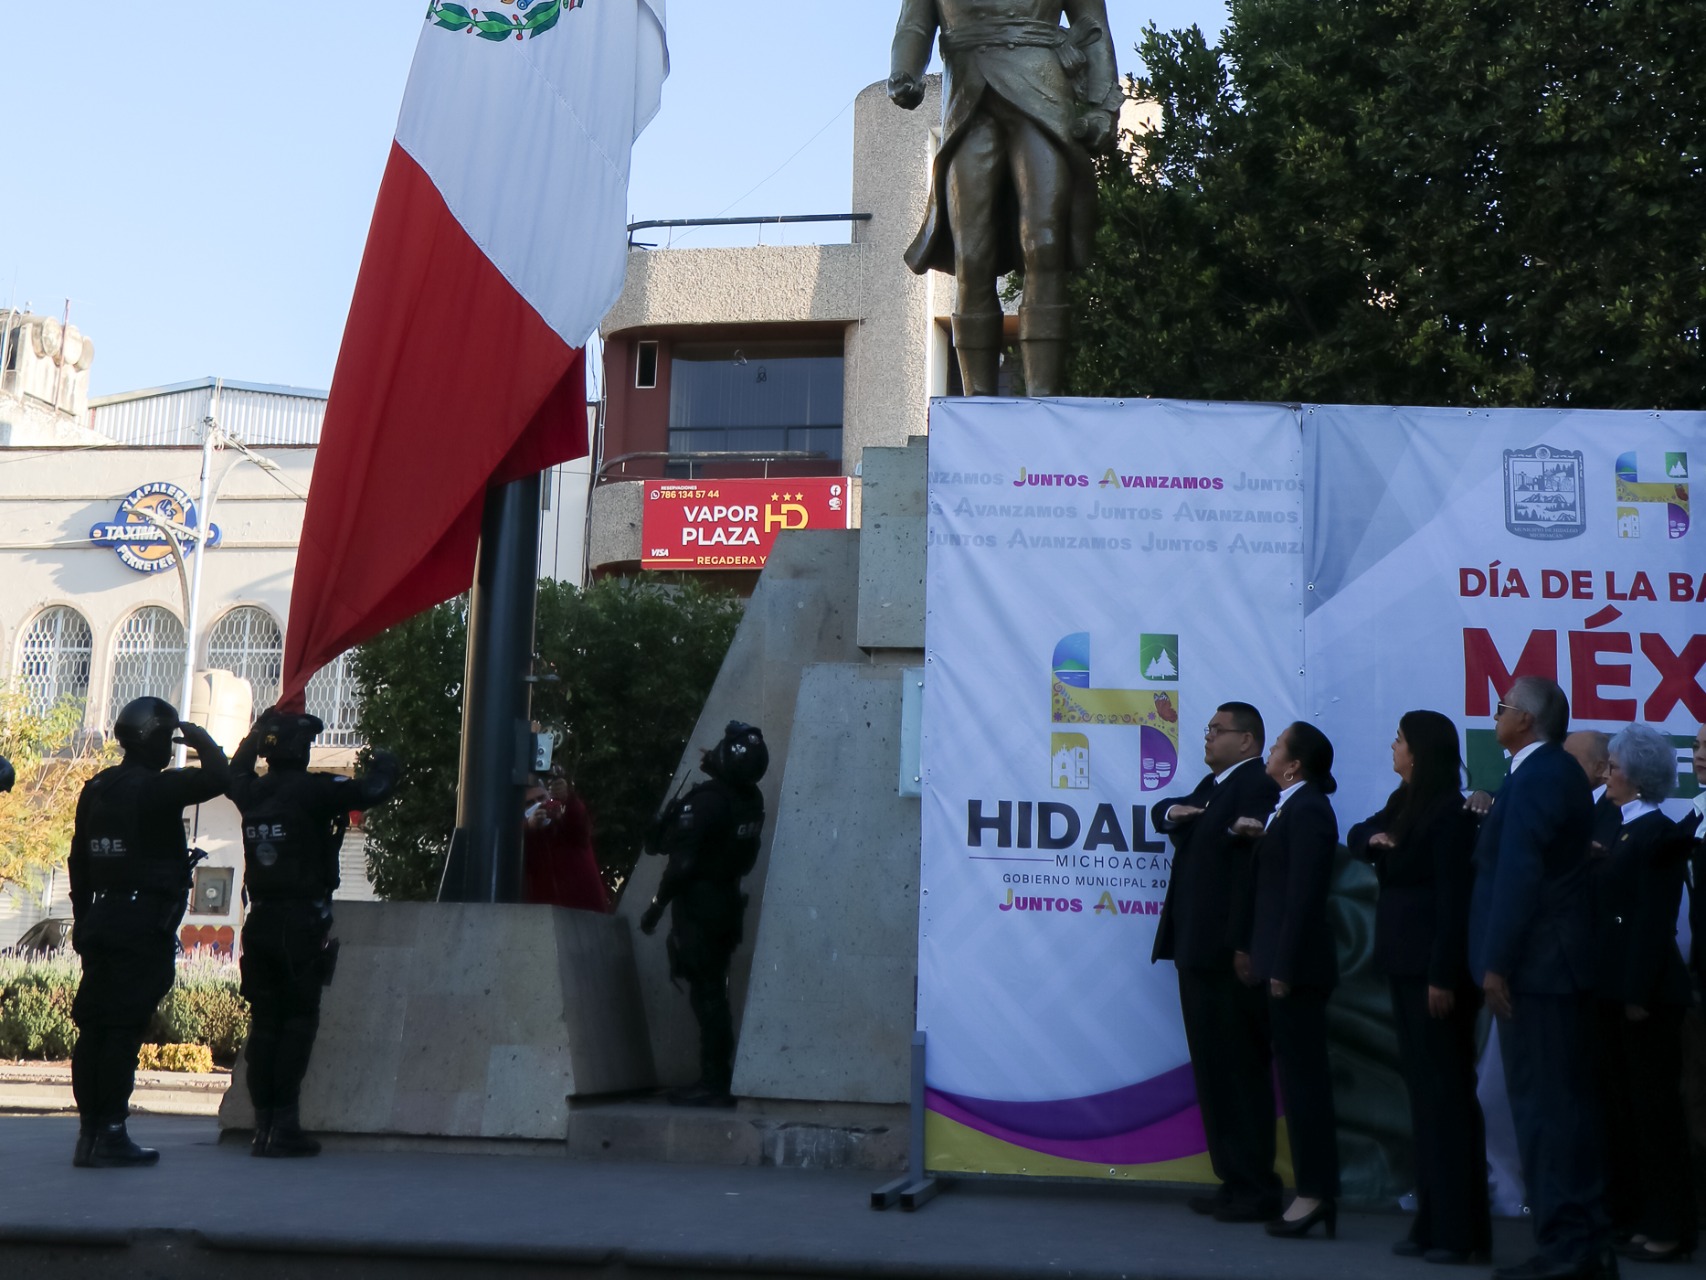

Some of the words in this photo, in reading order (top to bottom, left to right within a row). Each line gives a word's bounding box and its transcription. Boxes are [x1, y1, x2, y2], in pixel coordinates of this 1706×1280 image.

[1013, 466, 1089, 488] JUNTOS
[1098, 468, 1224, 490] AVANZAMOS
[661, 490, 676, 499] 786
[678, 490, 693, 499] 134
[695, 490, 706, 498] 57
[708, 490, 719, 498] 44
[683, 505, 759, 523] VAPOR
[764, 503, 809, 533] HD
[1086, 500, 1163, 521] JUNTOS
[682, 527, 760, 546] PLAZA
[1141, 532, 1218, 553] JUNTOS
[651, 549, 669, 557] VISA
[697, 556, 755, 565] REGADERA
[756, 556, 767, 565] Y
[1459, 560, 1529, 598] DÍA
[1541, 569, 1593, 600] DE
[1605, 571, 1657, 601] LA
[967, 799, 1166, 853] HIDAL
[1003, 873, 1070, 885] GOBIERNO
[1075, 876, 1147, 888] MUNICIPAL
[1151, 879, 1168, 889] 20
[998, 887, 1083, 913] JUNTOS
